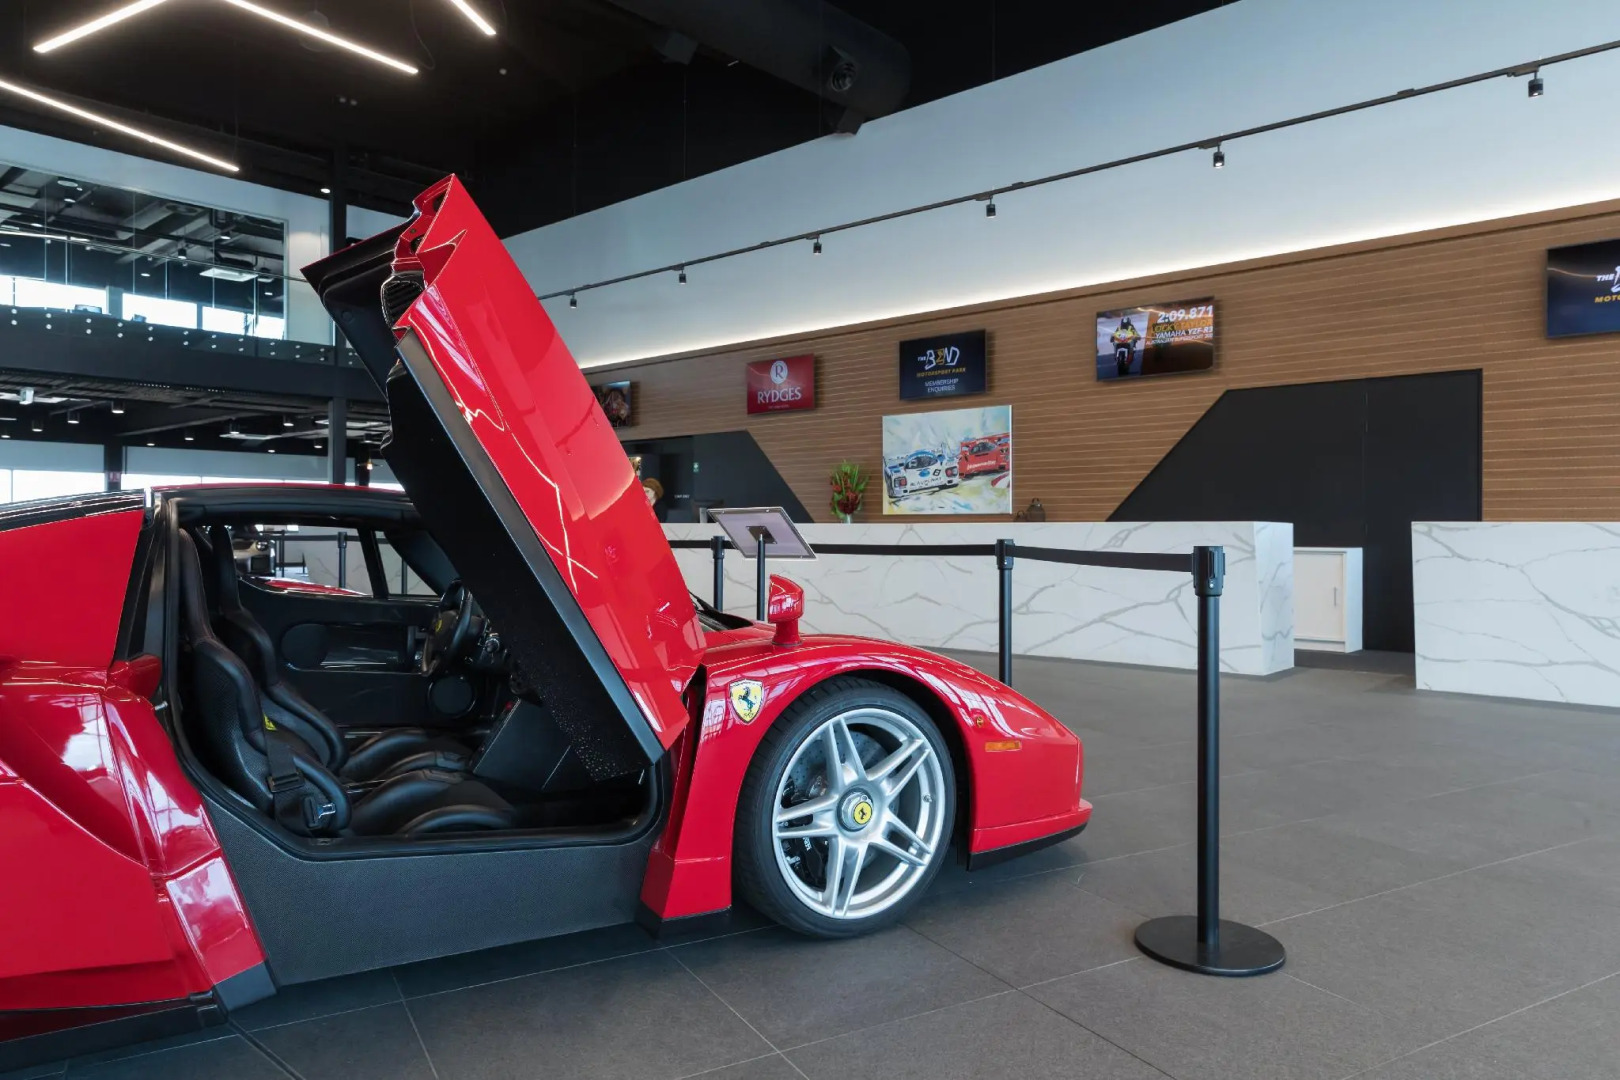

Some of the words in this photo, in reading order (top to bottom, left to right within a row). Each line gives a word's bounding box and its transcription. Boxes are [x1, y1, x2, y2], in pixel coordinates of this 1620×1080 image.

[1596, 273, 1614, 281] THE
[1157, 305, 1213, 323] 2:09.871
[1155, 330, 1186, 339] YAMAHA
[925, 346, 960, 370] BEND
[775, 365, 784, 379] R
[917, 369, 951, 377] MOTORSPORT
[925, 378, 959, 387] MEMBERSHIP
[928, 385, 955, 393] ENQUIRIES
[757, 387, 802, 404] RYDGES
